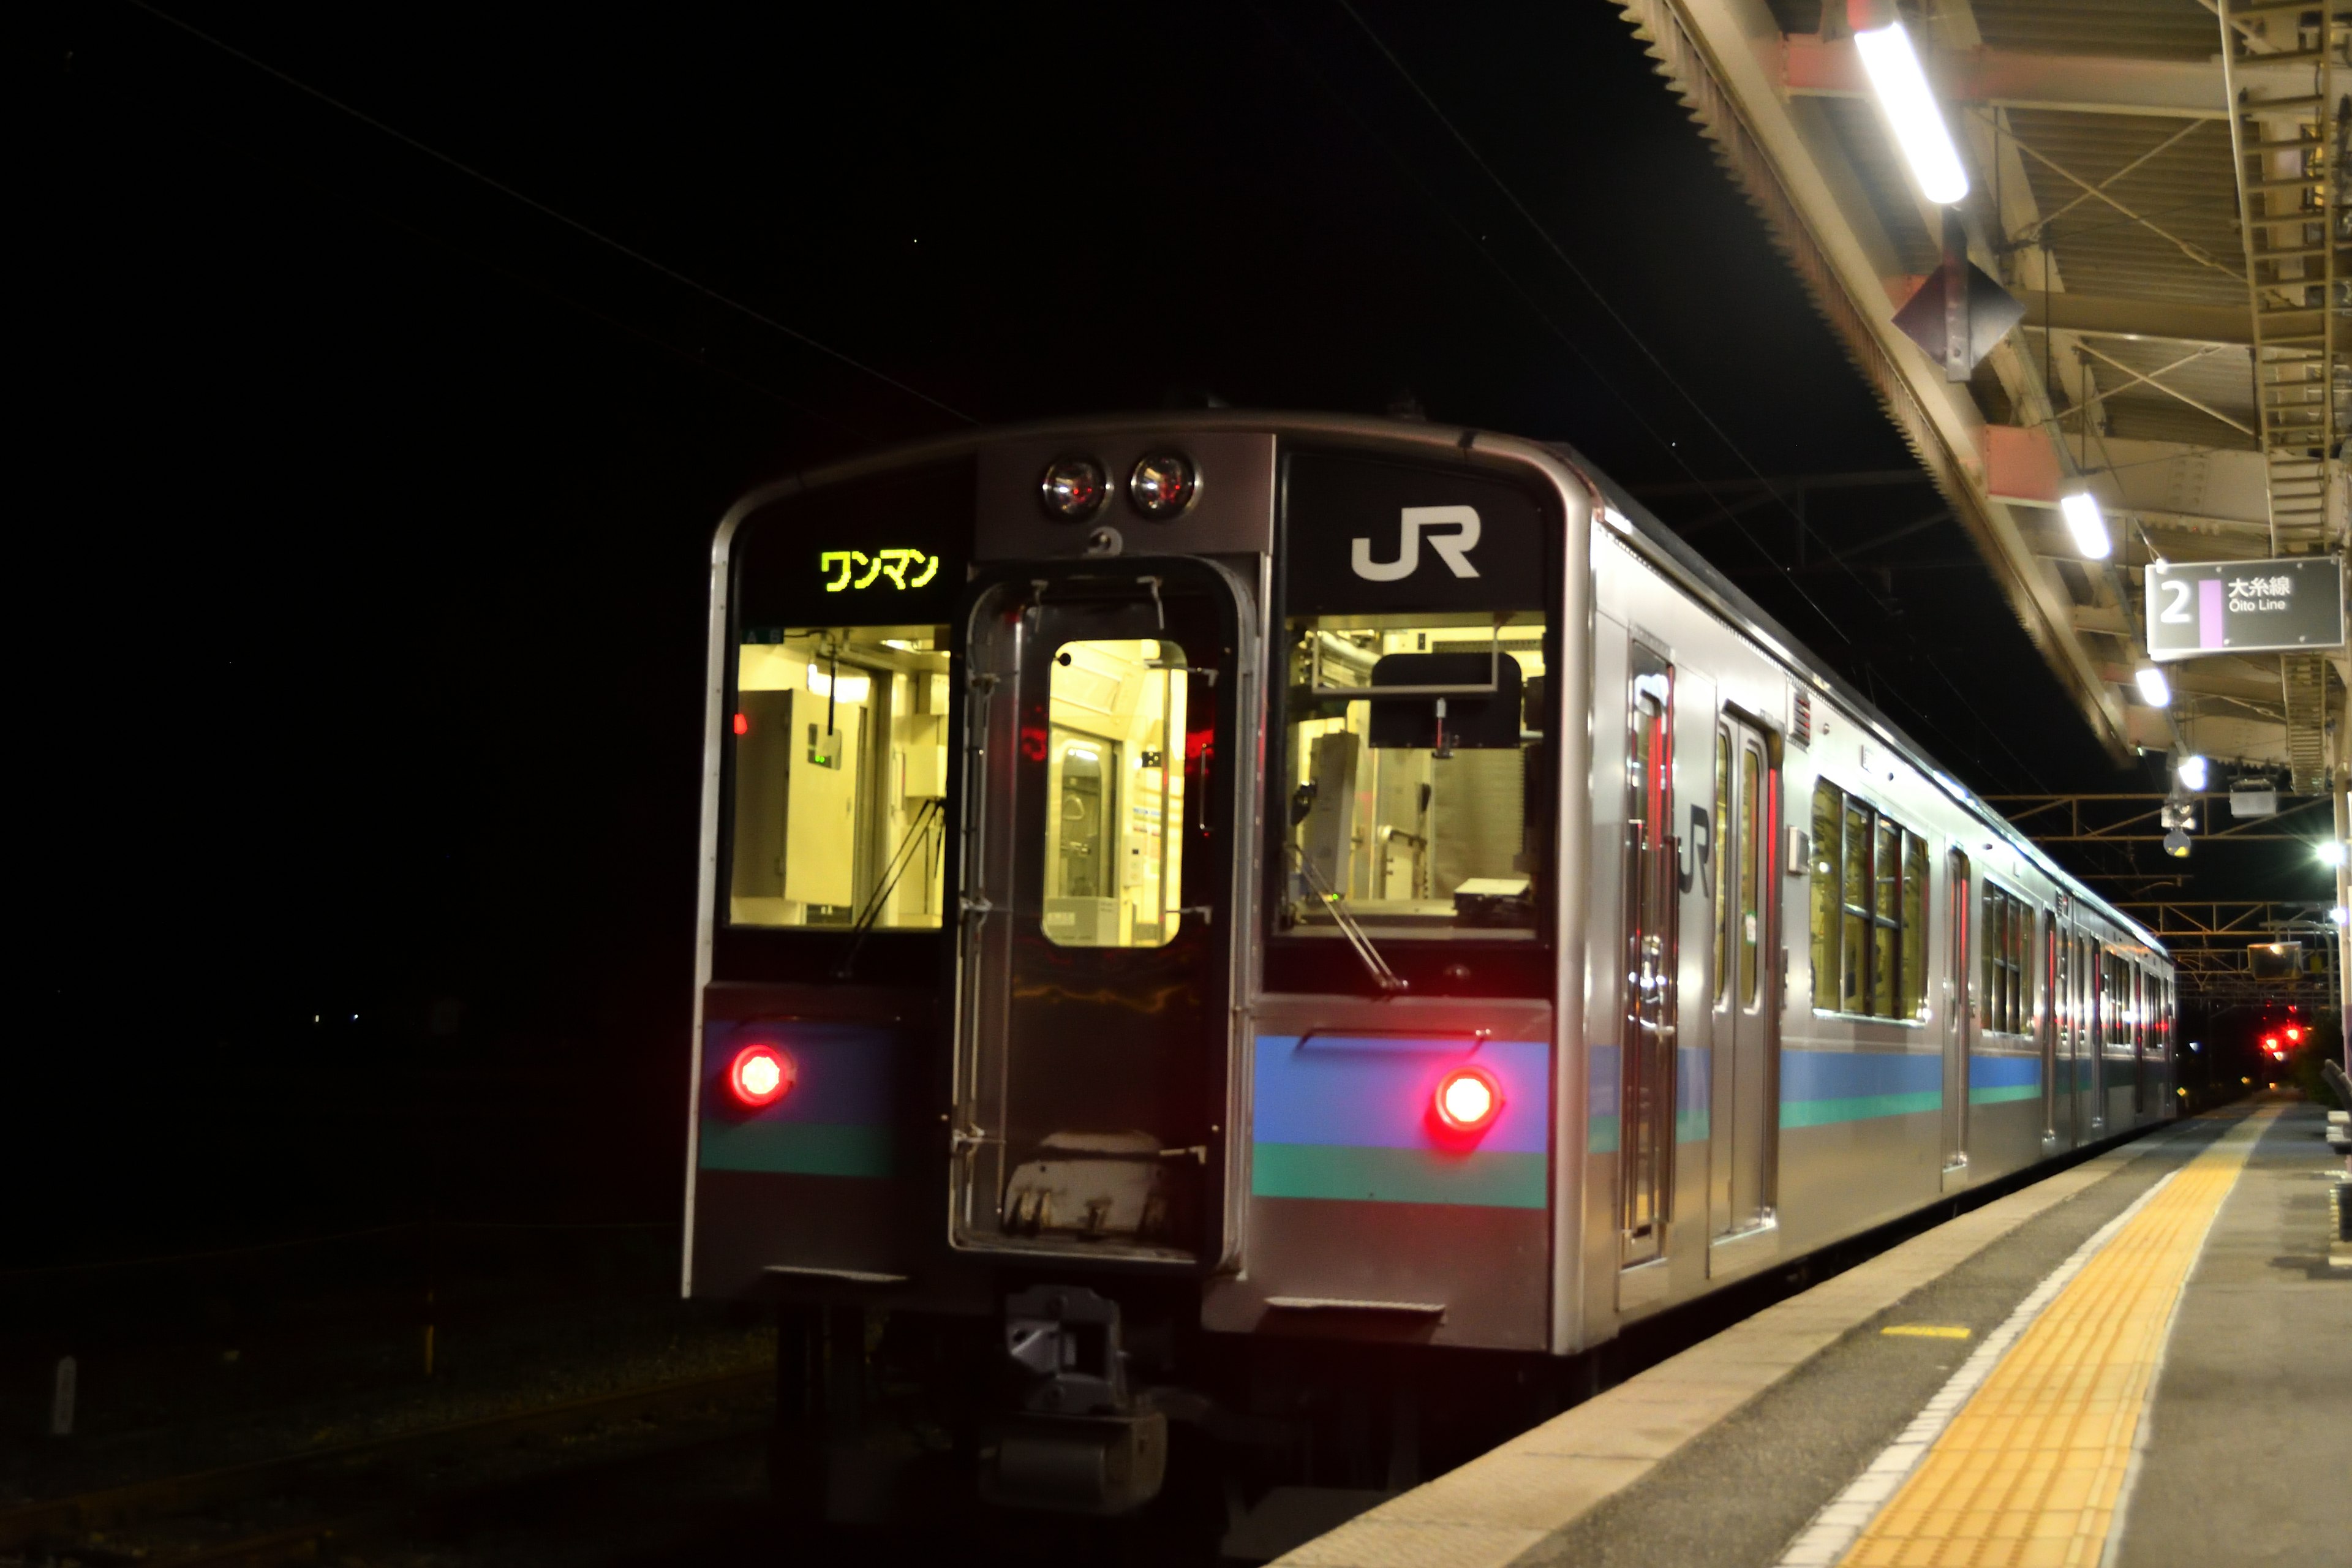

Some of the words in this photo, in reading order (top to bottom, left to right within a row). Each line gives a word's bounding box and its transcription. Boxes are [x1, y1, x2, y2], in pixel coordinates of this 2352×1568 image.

[1351, 505, 1481, 582] JR
[821, 549, 938, 592] ワンマン
[2228, 576, 2290, 597] 大糸線
[2160, 580, 2190, 624] 2
[2259, 598, 2286, 611] Line
[1678, 804, 1709, 898] JR
